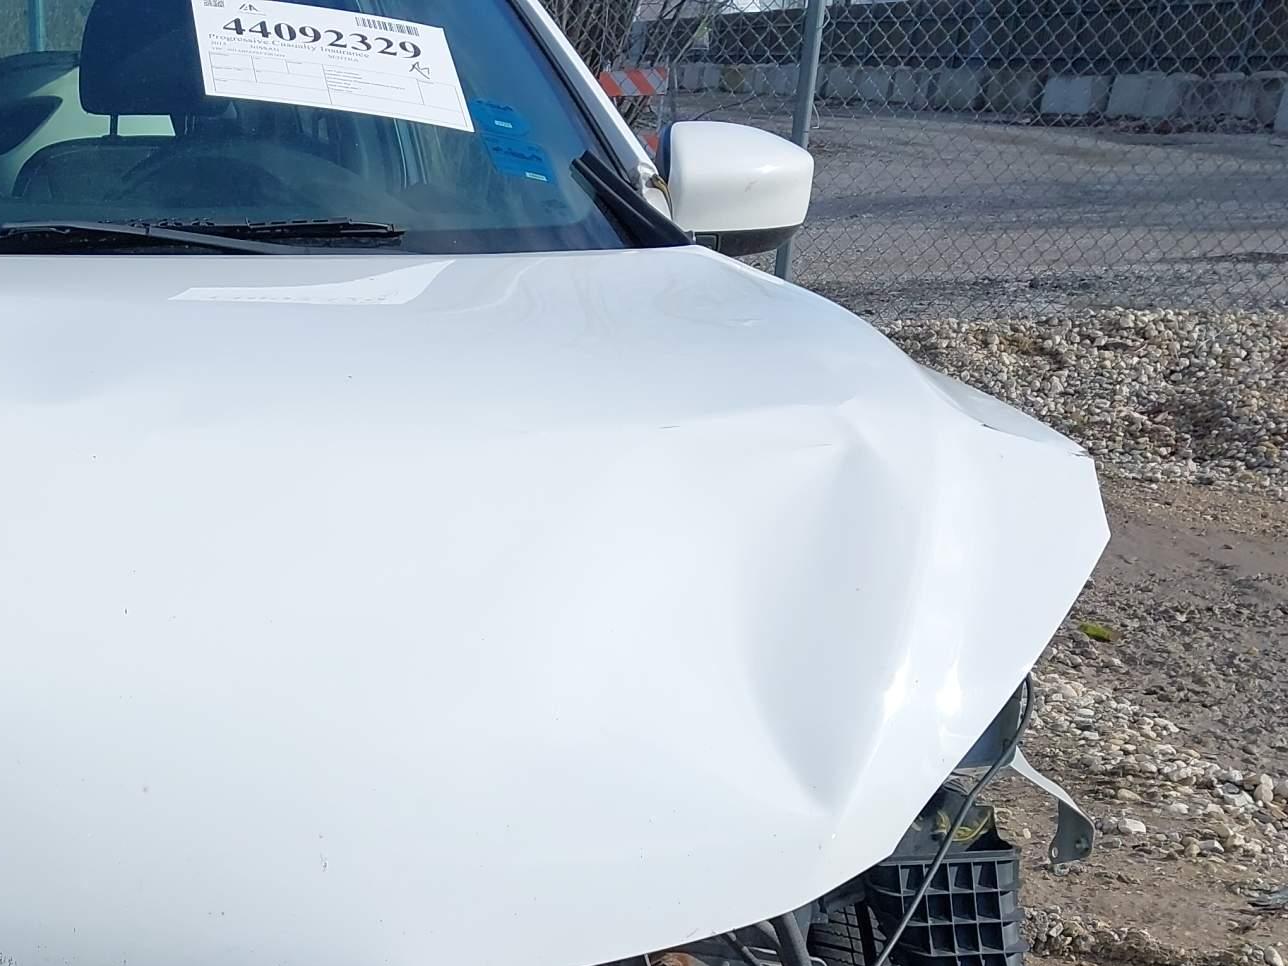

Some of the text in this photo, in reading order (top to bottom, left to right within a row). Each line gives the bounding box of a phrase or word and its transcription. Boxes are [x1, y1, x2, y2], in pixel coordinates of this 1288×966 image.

[208, 33, 268, 45] Progressive
[320, 46, 370, 58] Insurance
[222, 17, 422, 59] 44092329
